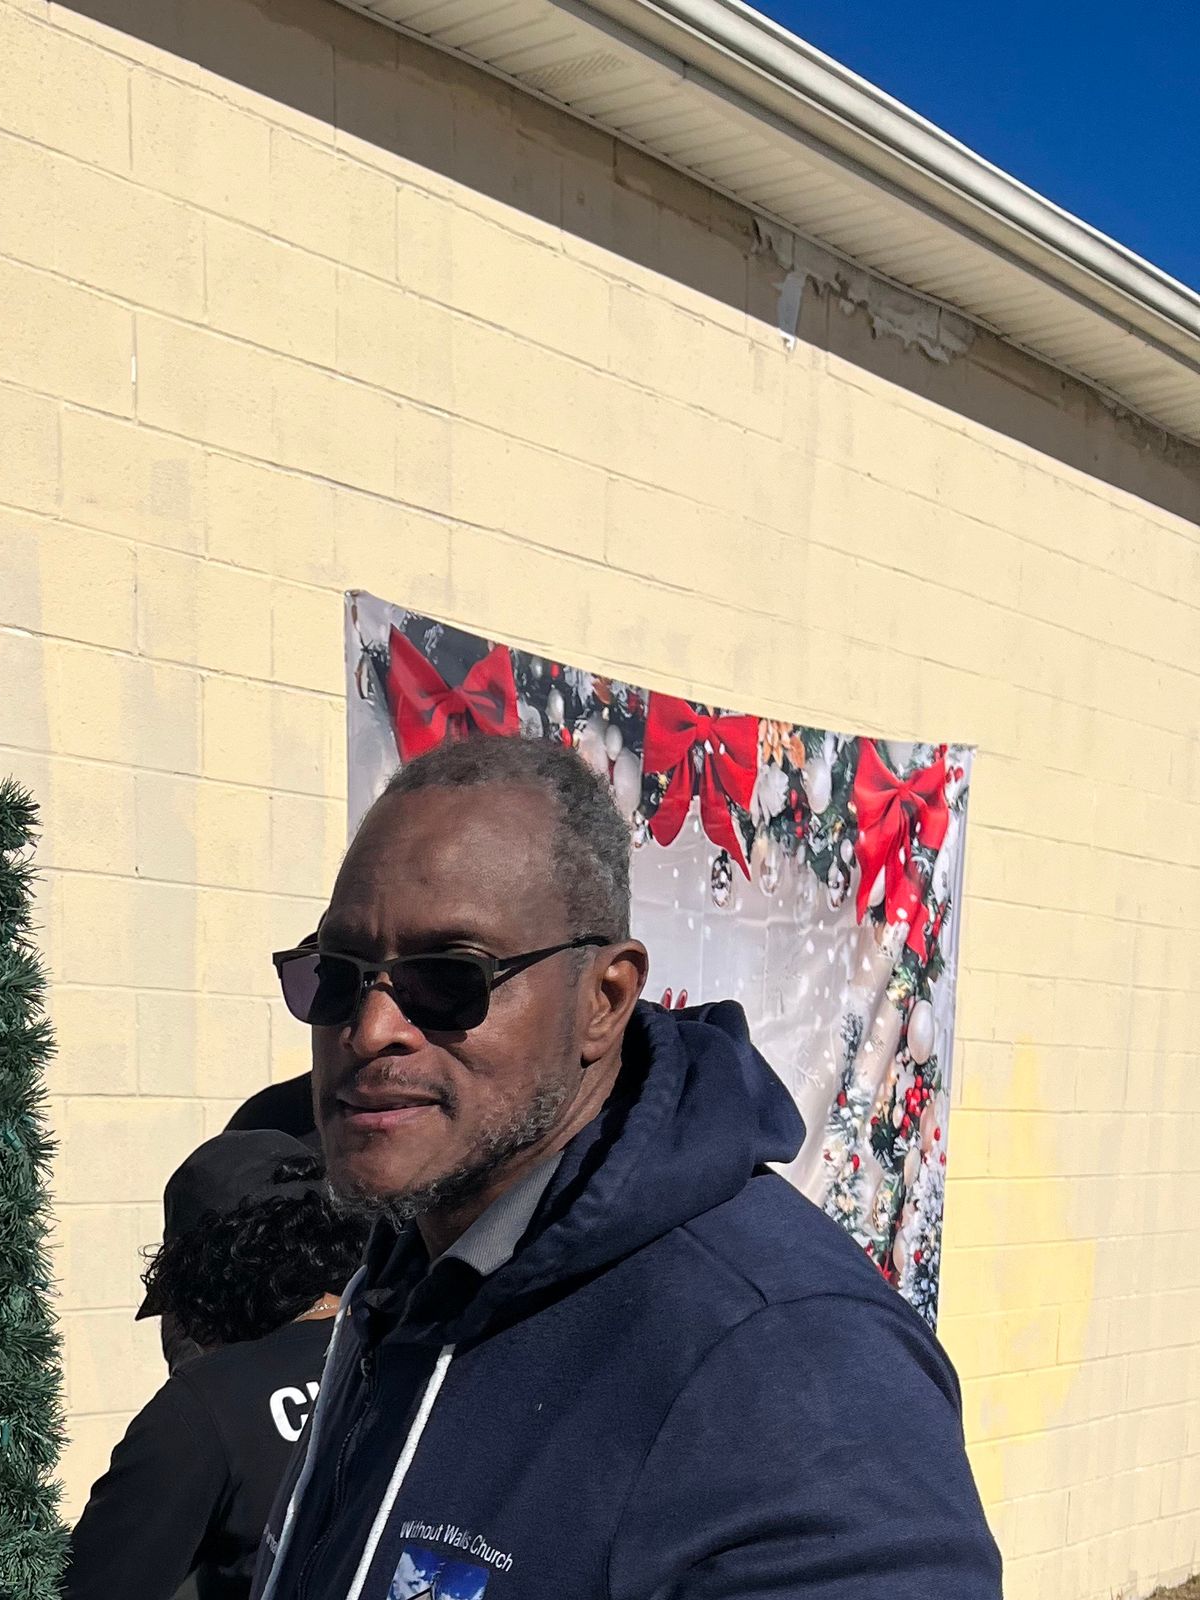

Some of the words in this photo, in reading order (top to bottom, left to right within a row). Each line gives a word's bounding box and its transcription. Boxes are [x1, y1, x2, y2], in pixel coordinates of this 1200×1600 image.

[400, 1521, 443, 1541] Without
[443, 1524, 471, 1550] Walls
[470, 1534, 513, 1572] Church
